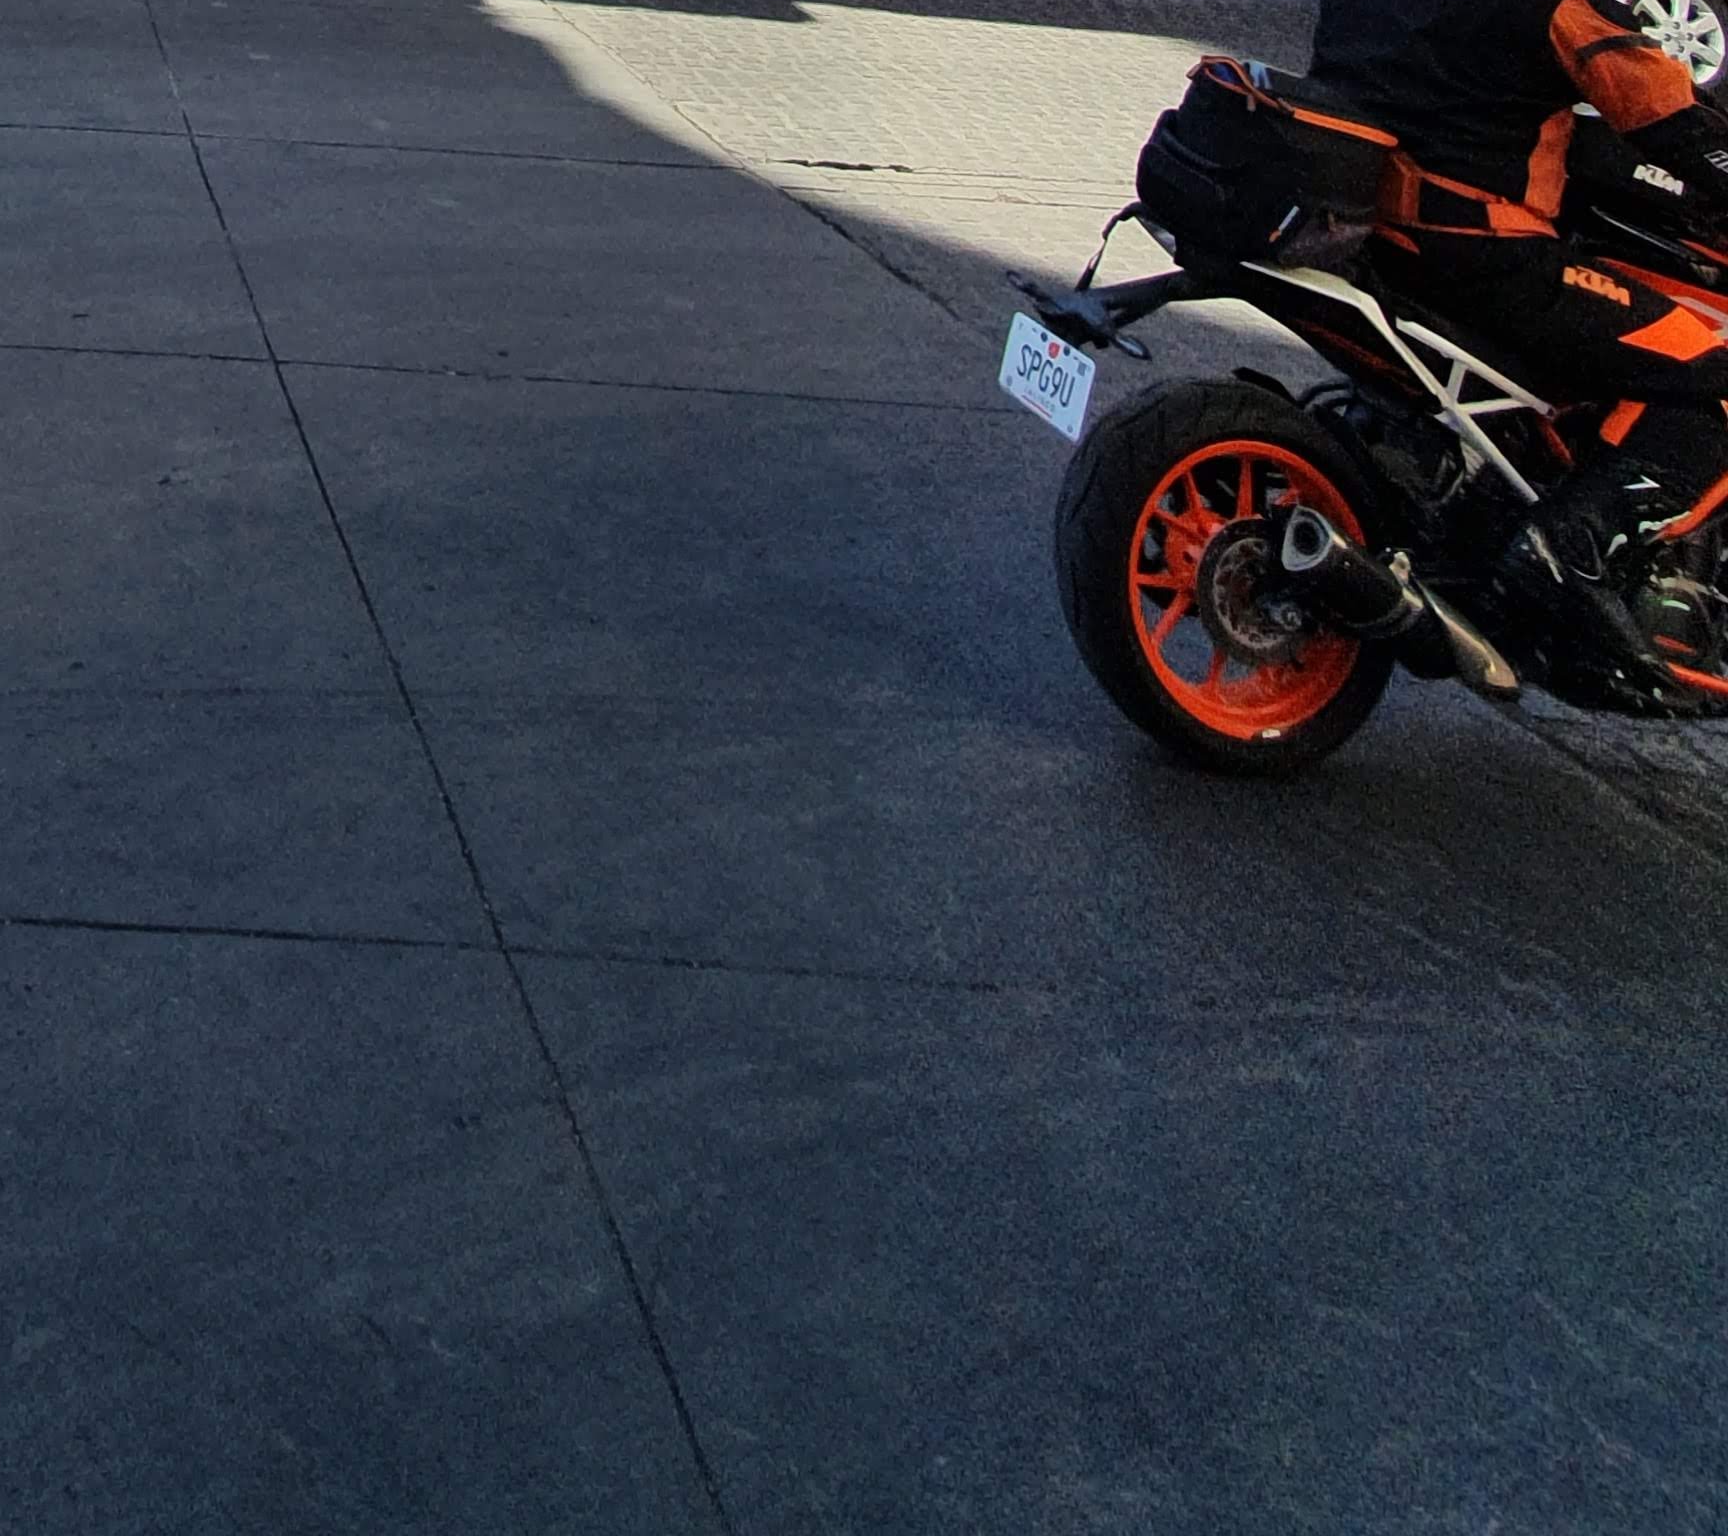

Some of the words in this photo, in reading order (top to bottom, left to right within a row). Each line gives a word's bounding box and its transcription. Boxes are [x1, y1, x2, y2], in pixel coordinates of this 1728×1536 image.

[1633, 163, 1684, 196] KTM
[1562, 265, 1631, 306] KTM
[1016, 343, 1075, 407] SPG9U
